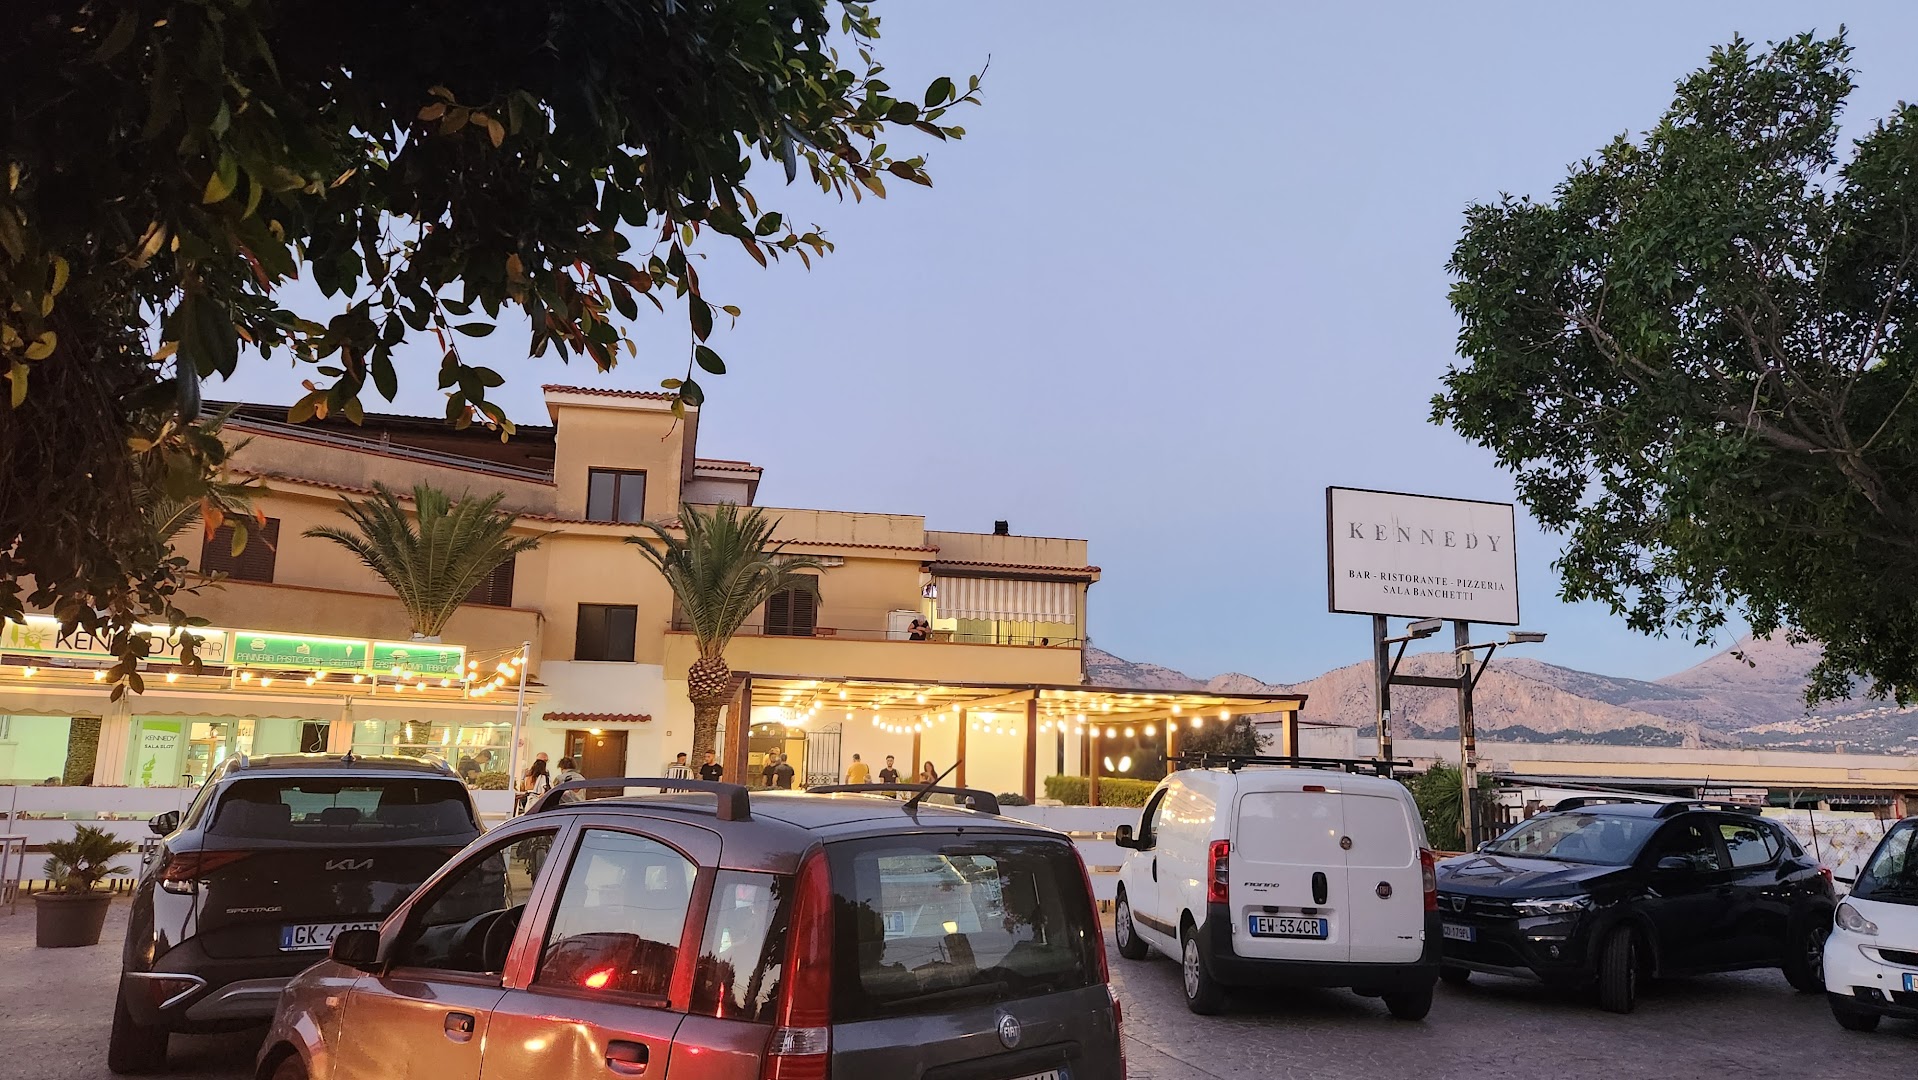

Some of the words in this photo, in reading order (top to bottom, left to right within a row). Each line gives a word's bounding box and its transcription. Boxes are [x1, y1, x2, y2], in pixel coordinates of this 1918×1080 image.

[1349, 521, 1501, 552] KENNEDY
[1349, 569, 1371, 580] BAR
[1380, 572, 1448, 586] RISTORANTE
[1457, 578, 1505, 591] PIZZERIA
[1383, 585, 1410, 596] SALA
[1413, 587, 1474, 601] BANCHETTI
[56, 630, 181, 656] KENDY
[226, 905, 282, 914] SPORTAGE
[1003, 1025, 1018, 1038] FIAT
